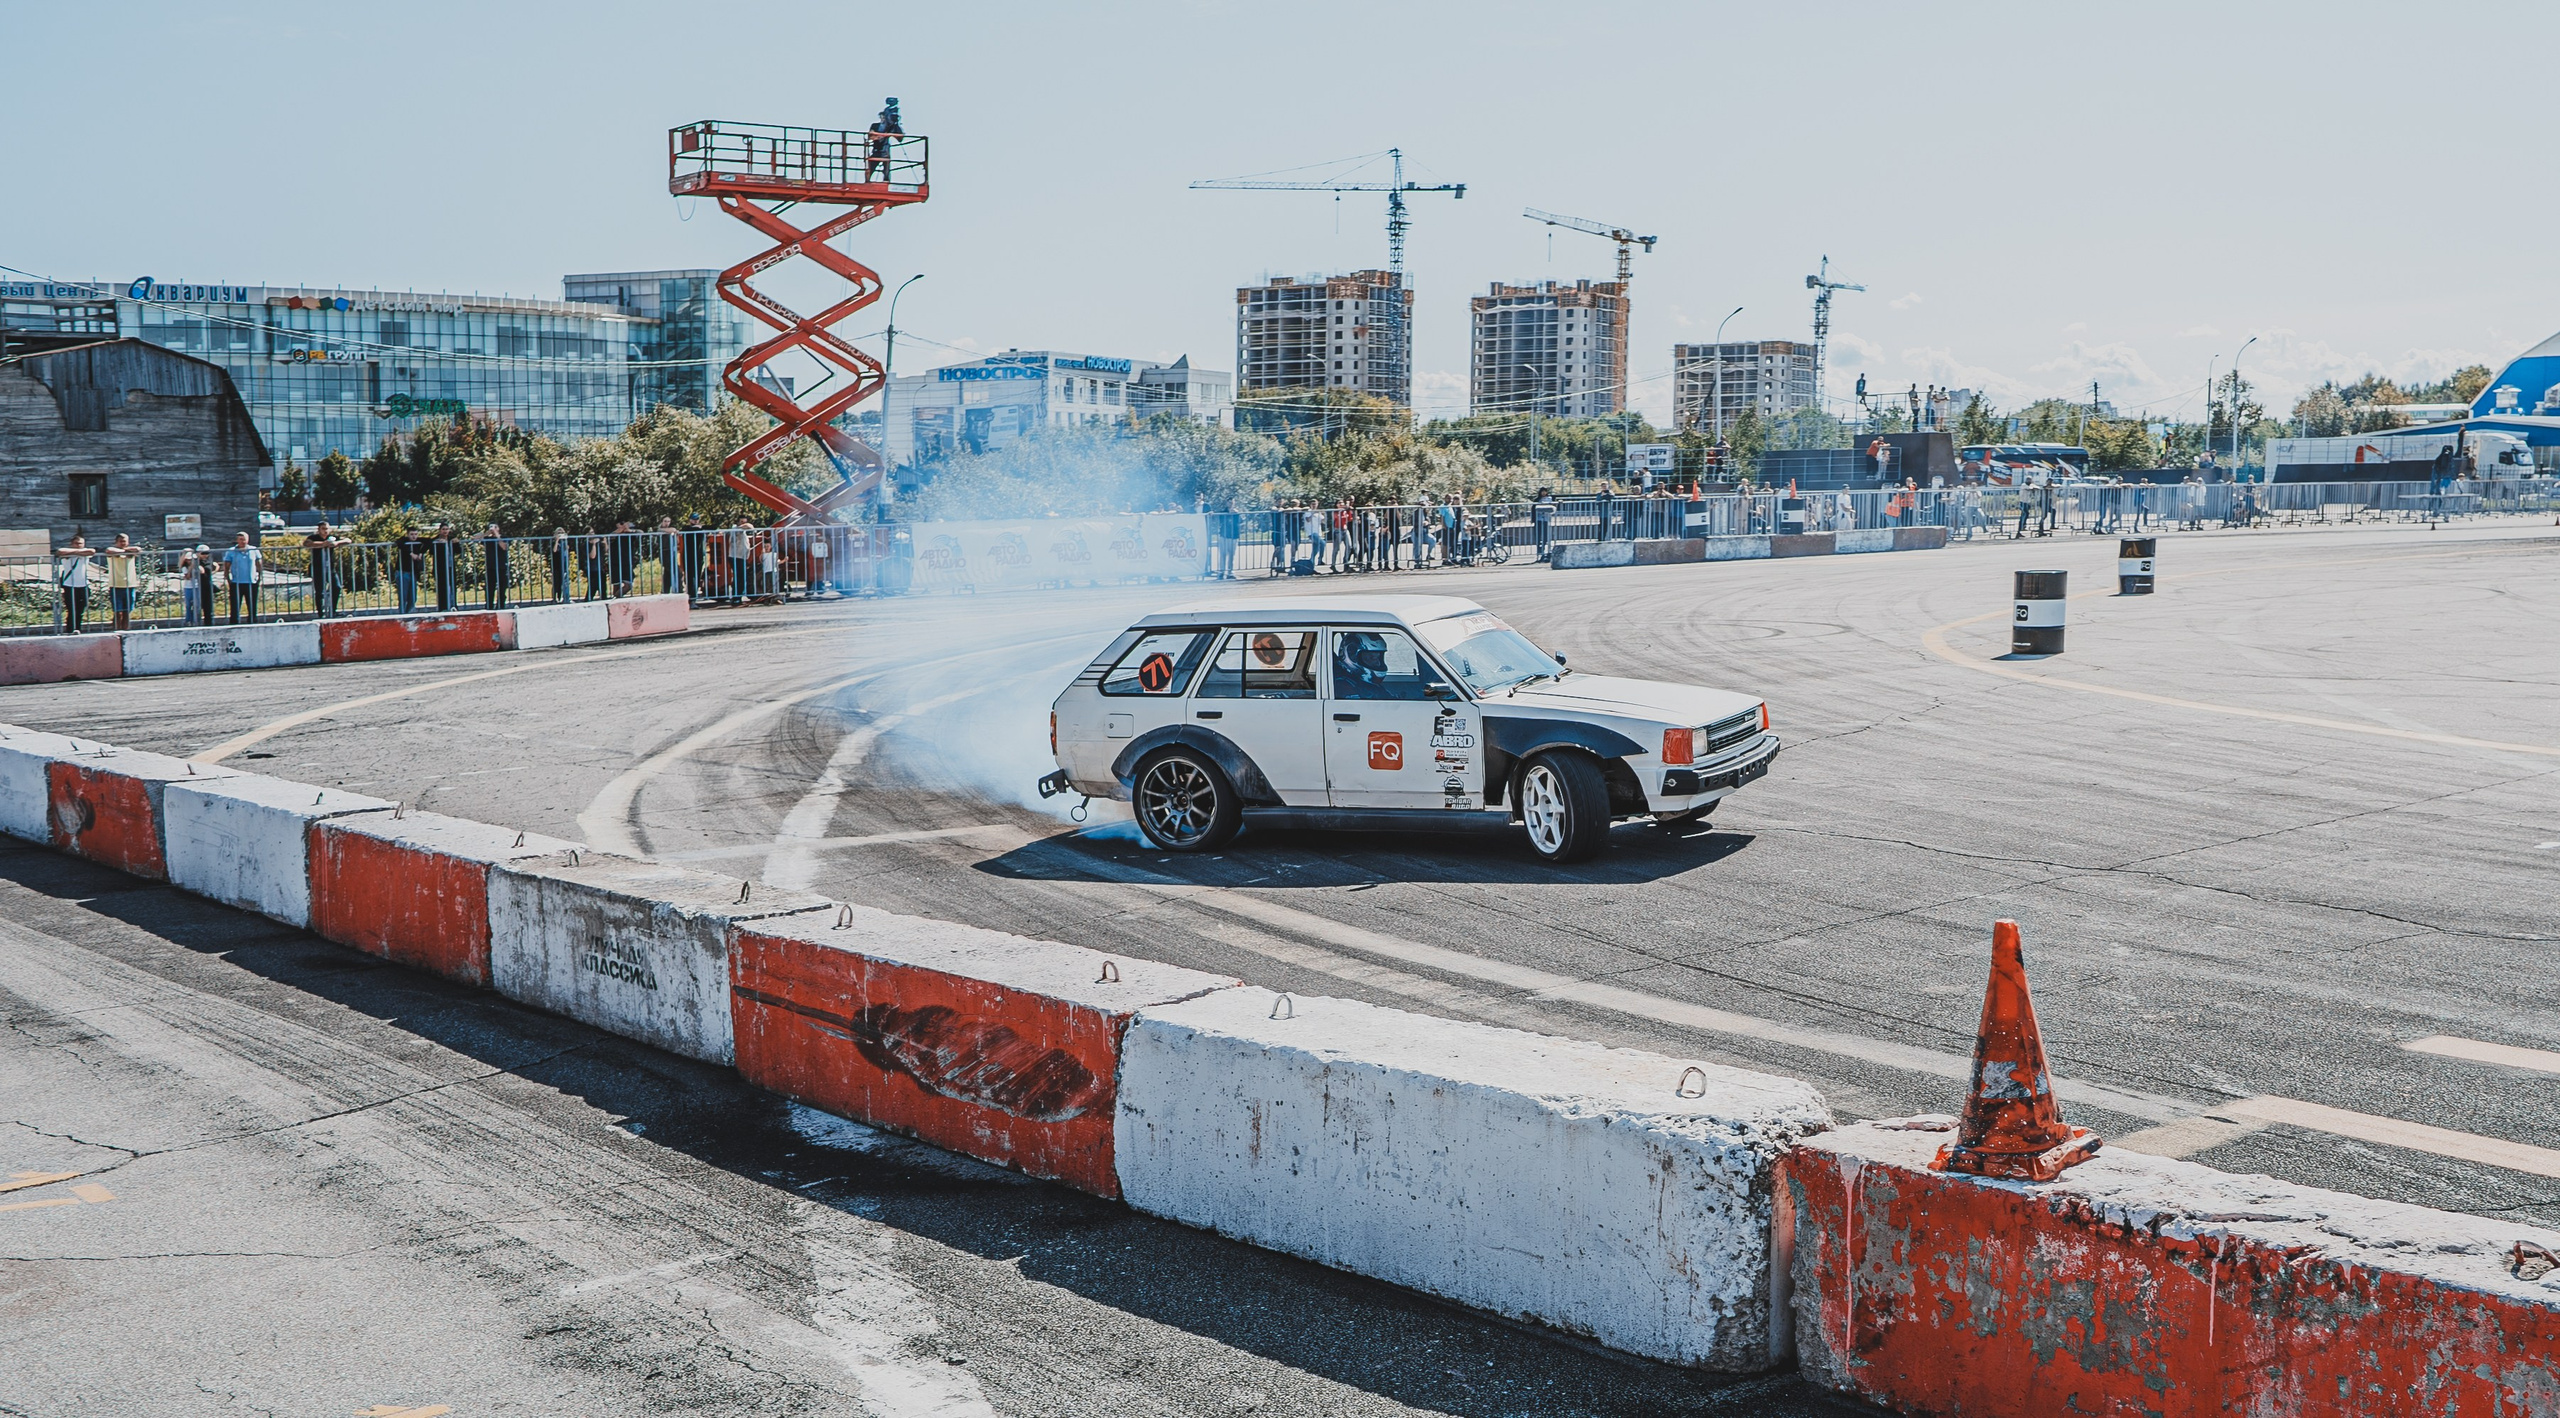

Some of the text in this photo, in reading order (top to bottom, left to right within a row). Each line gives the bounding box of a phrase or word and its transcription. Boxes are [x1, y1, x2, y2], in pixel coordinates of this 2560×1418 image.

[751, 243, 803, 273] АРЕНДА
[755, 428, 804, 462] СЕРВИС
[1161, 538, 1185, 549] АВТО
[919, 549, 950, 560] АВТО
[1168, 548, 1198, 559] РАДИО
[928, 558, 967, 569] РАДИО
[1142, 656, 1170, 688] 71
[1370, 741, 1400, 760] FQ
